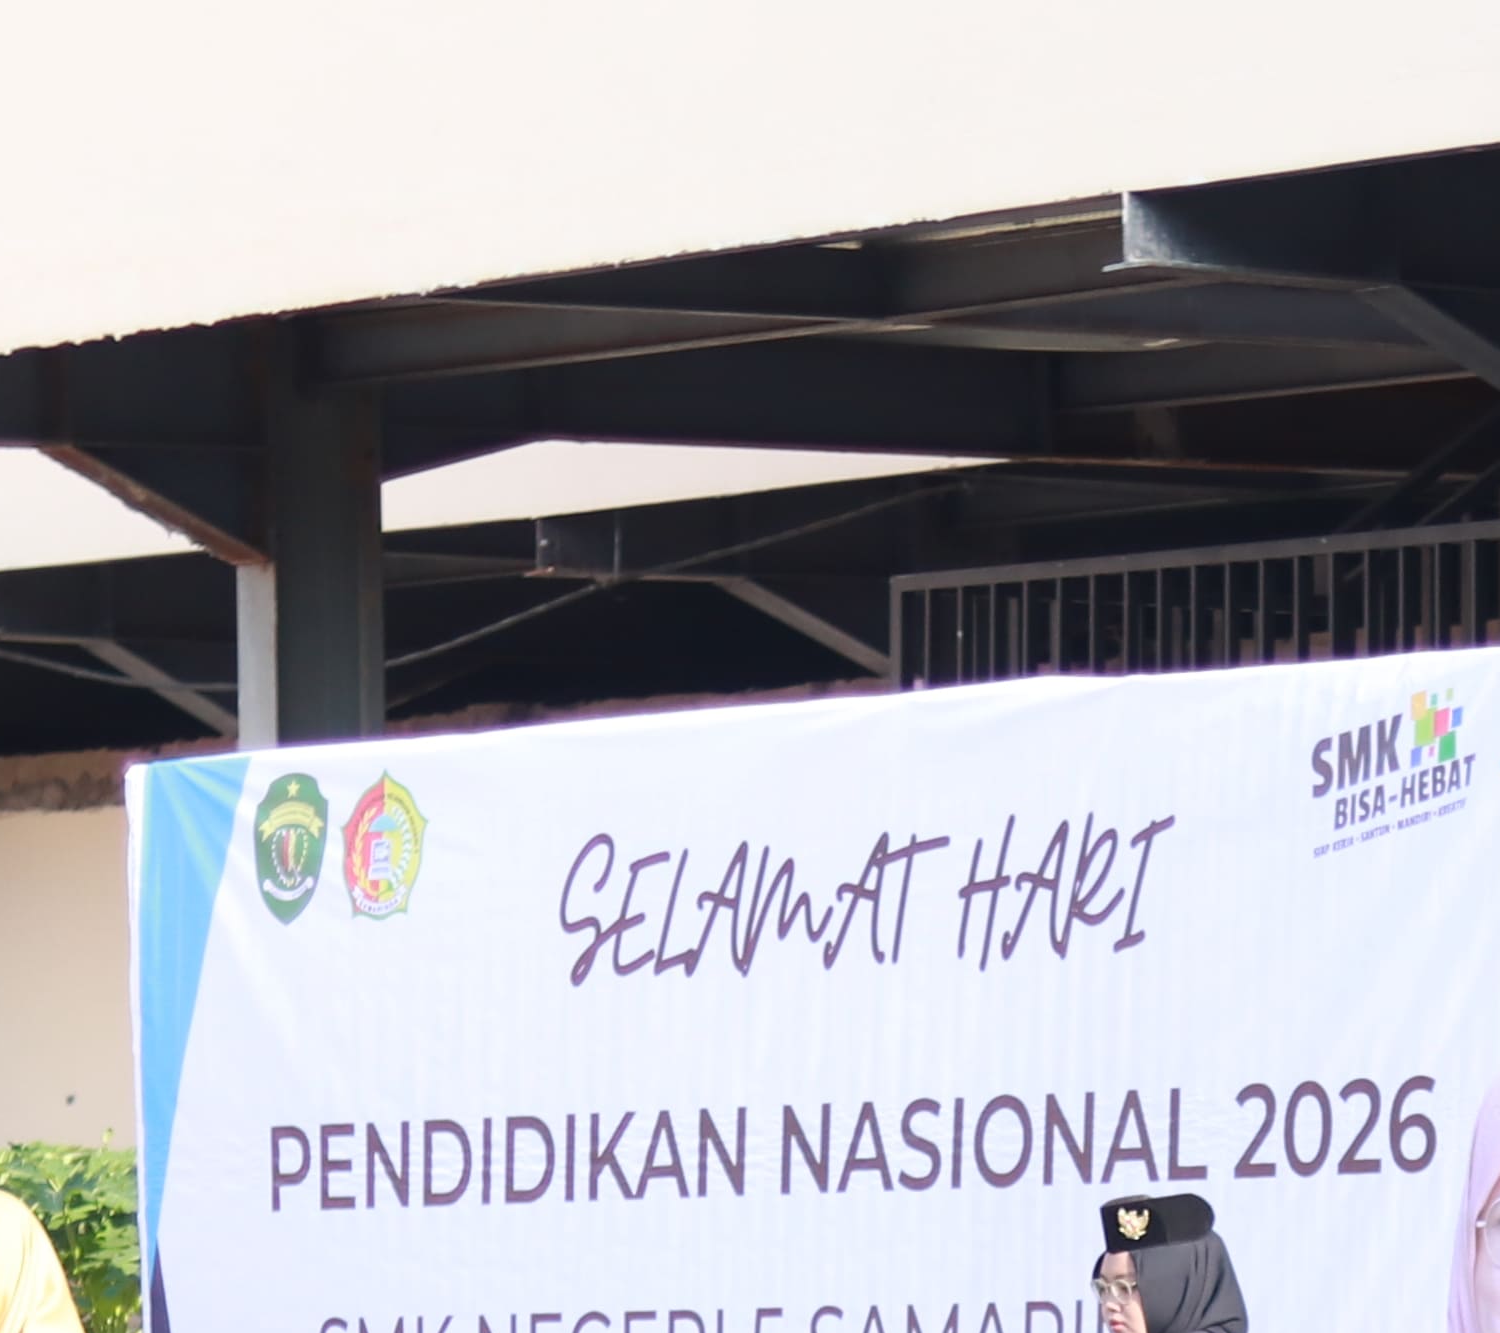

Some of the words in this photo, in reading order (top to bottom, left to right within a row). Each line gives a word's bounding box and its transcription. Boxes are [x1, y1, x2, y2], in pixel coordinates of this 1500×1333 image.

[1311, 713, 1402, 799] SMK
[1334, 753, 1476, 831] BISA-HEBAT
[957, 812, 1175, 972] HARI
[270, 1106, 747, 1212] PENDIDIKAN
[780, 1087, 1209, 1196] NASIONAL
[1233, 1075, 1437, 1179] 2026
